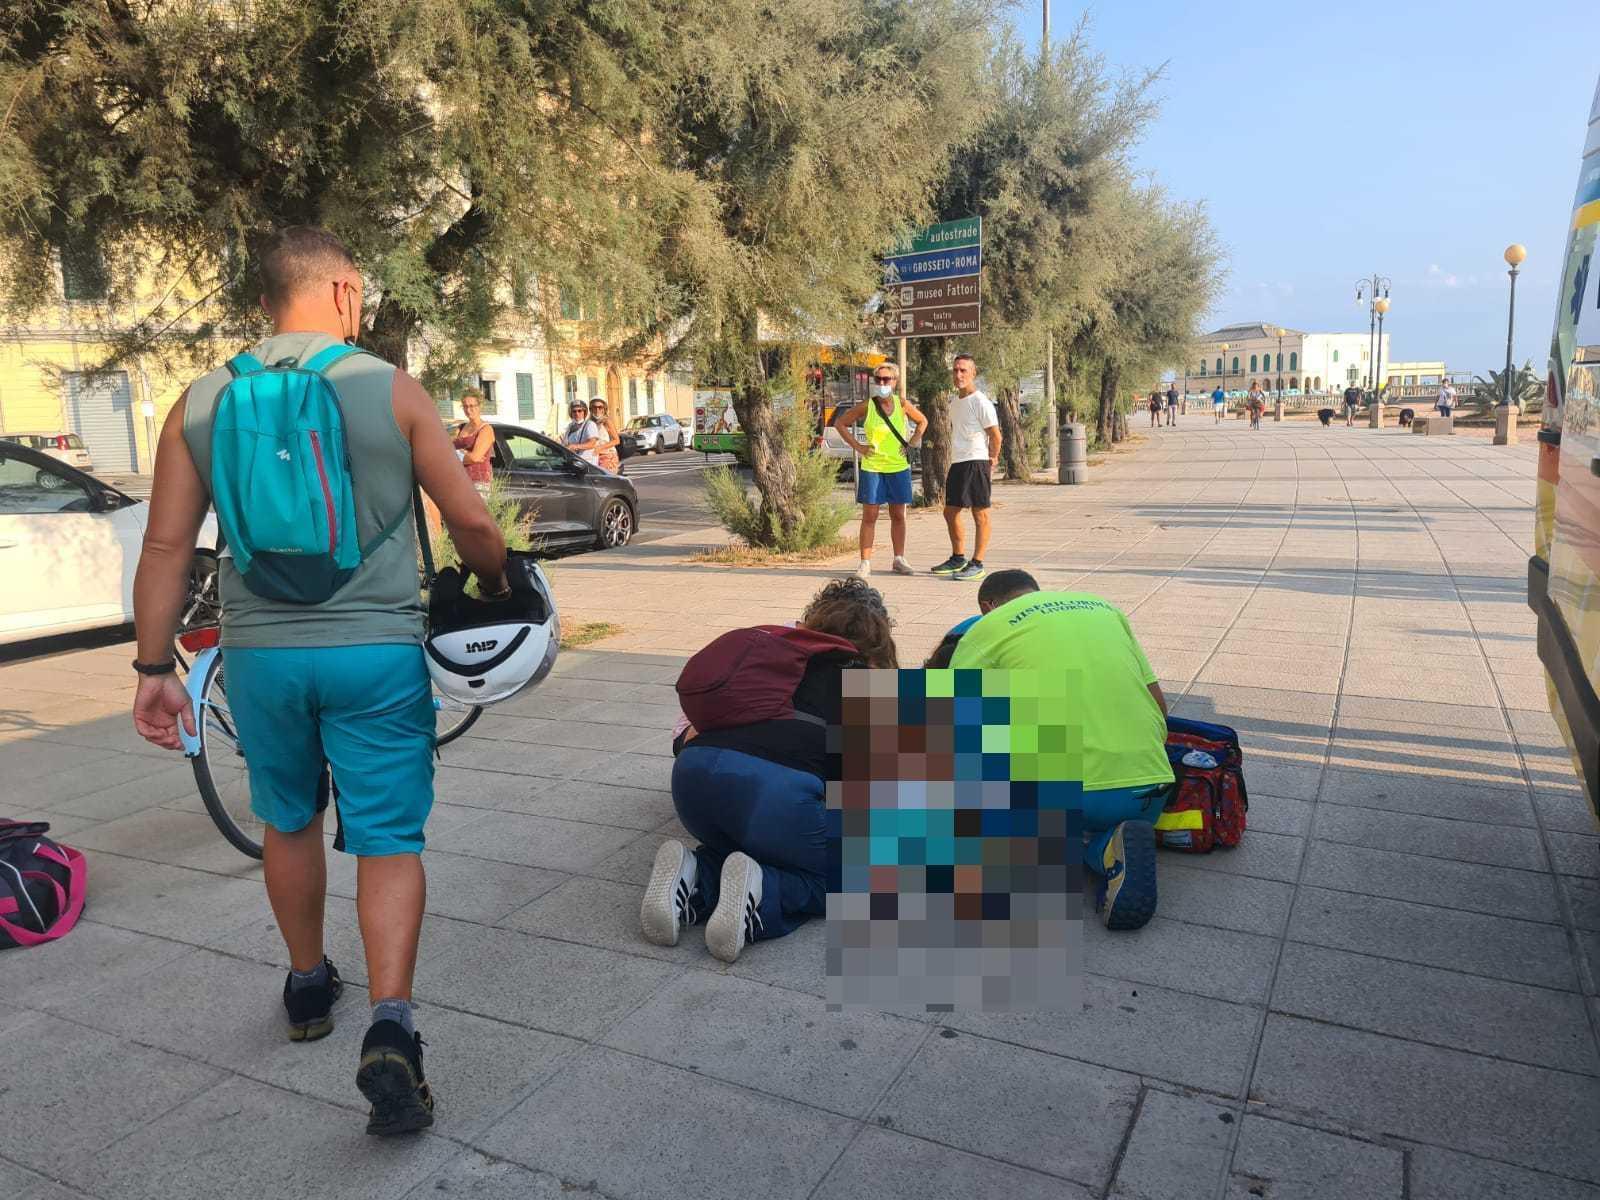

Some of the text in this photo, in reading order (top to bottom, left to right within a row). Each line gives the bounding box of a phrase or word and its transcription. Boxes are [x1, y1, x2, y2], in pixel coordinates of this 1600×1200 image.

[930, 225, 977, 243] autostrade
[917, 283, 977, 300] museo Fattori
[934, 321, 948, 331] villa
